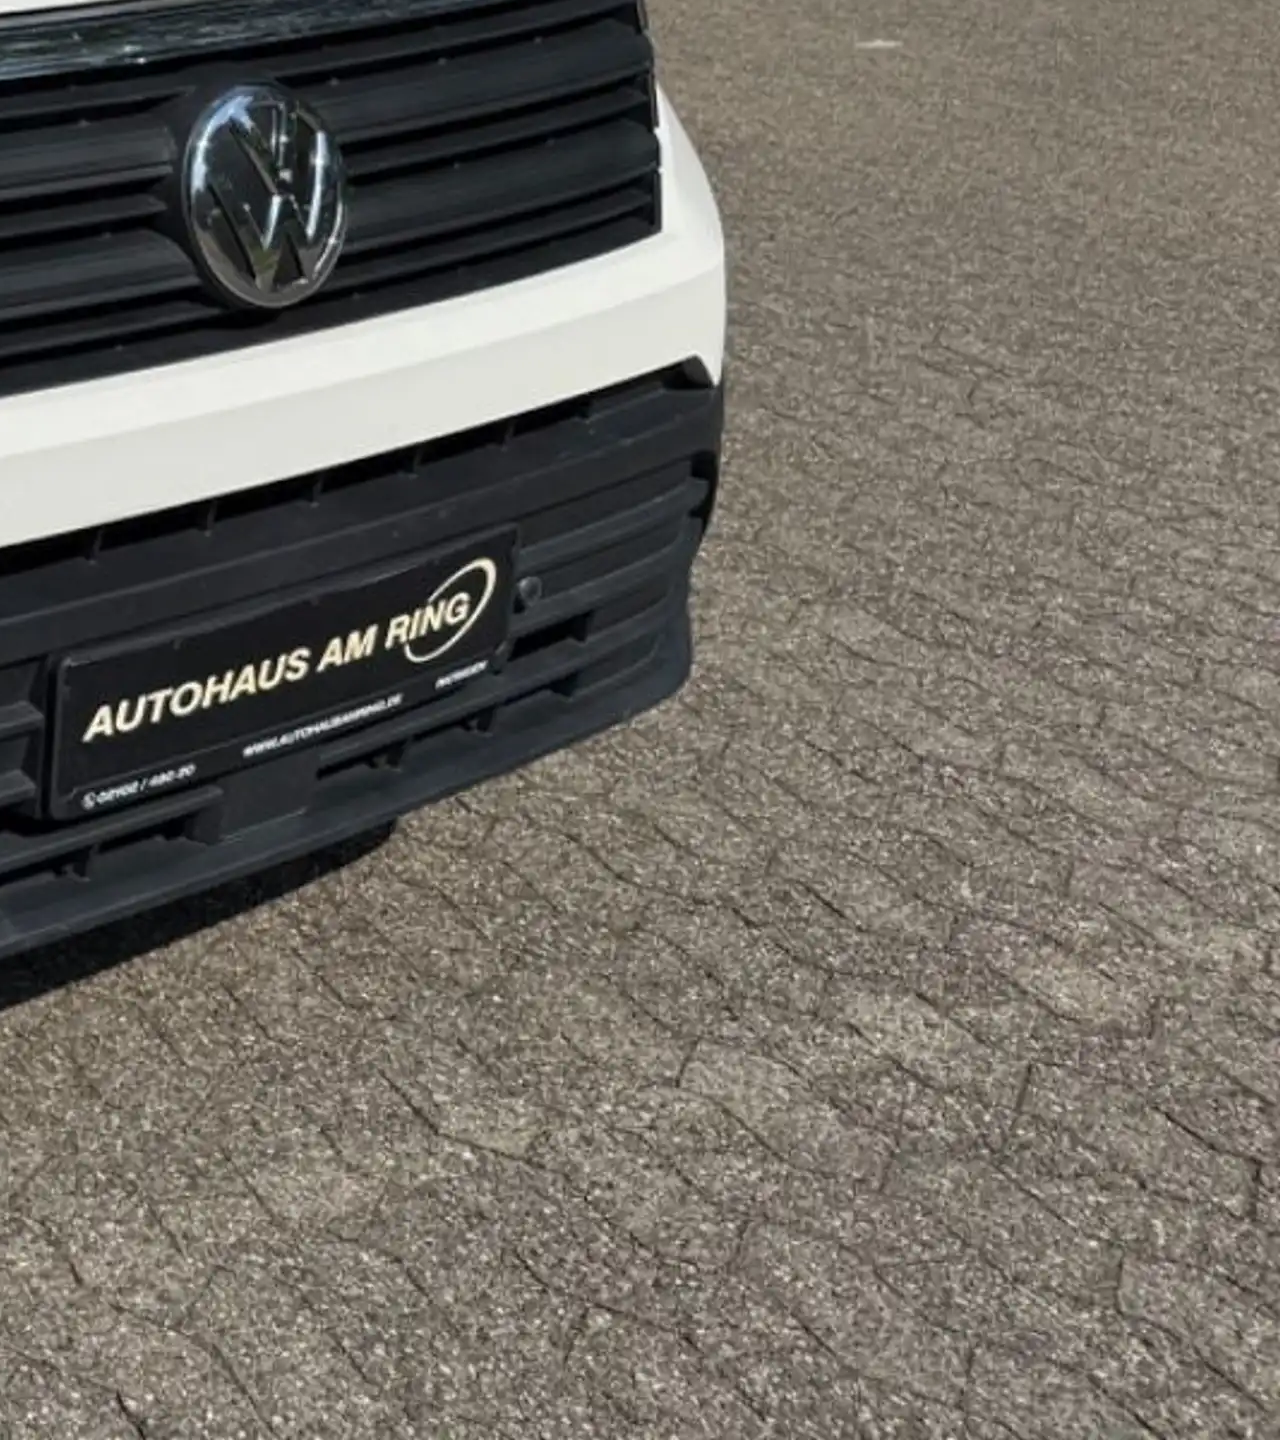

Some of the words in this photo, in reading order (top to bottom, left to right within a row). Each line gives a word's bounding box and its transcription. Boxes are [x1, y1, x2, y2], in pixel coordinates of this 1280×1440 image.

[82, 648, 311, 743] AUTOHAUS
[316, 624, 378, 672] AM
[385, 592, 472, 651] RING
